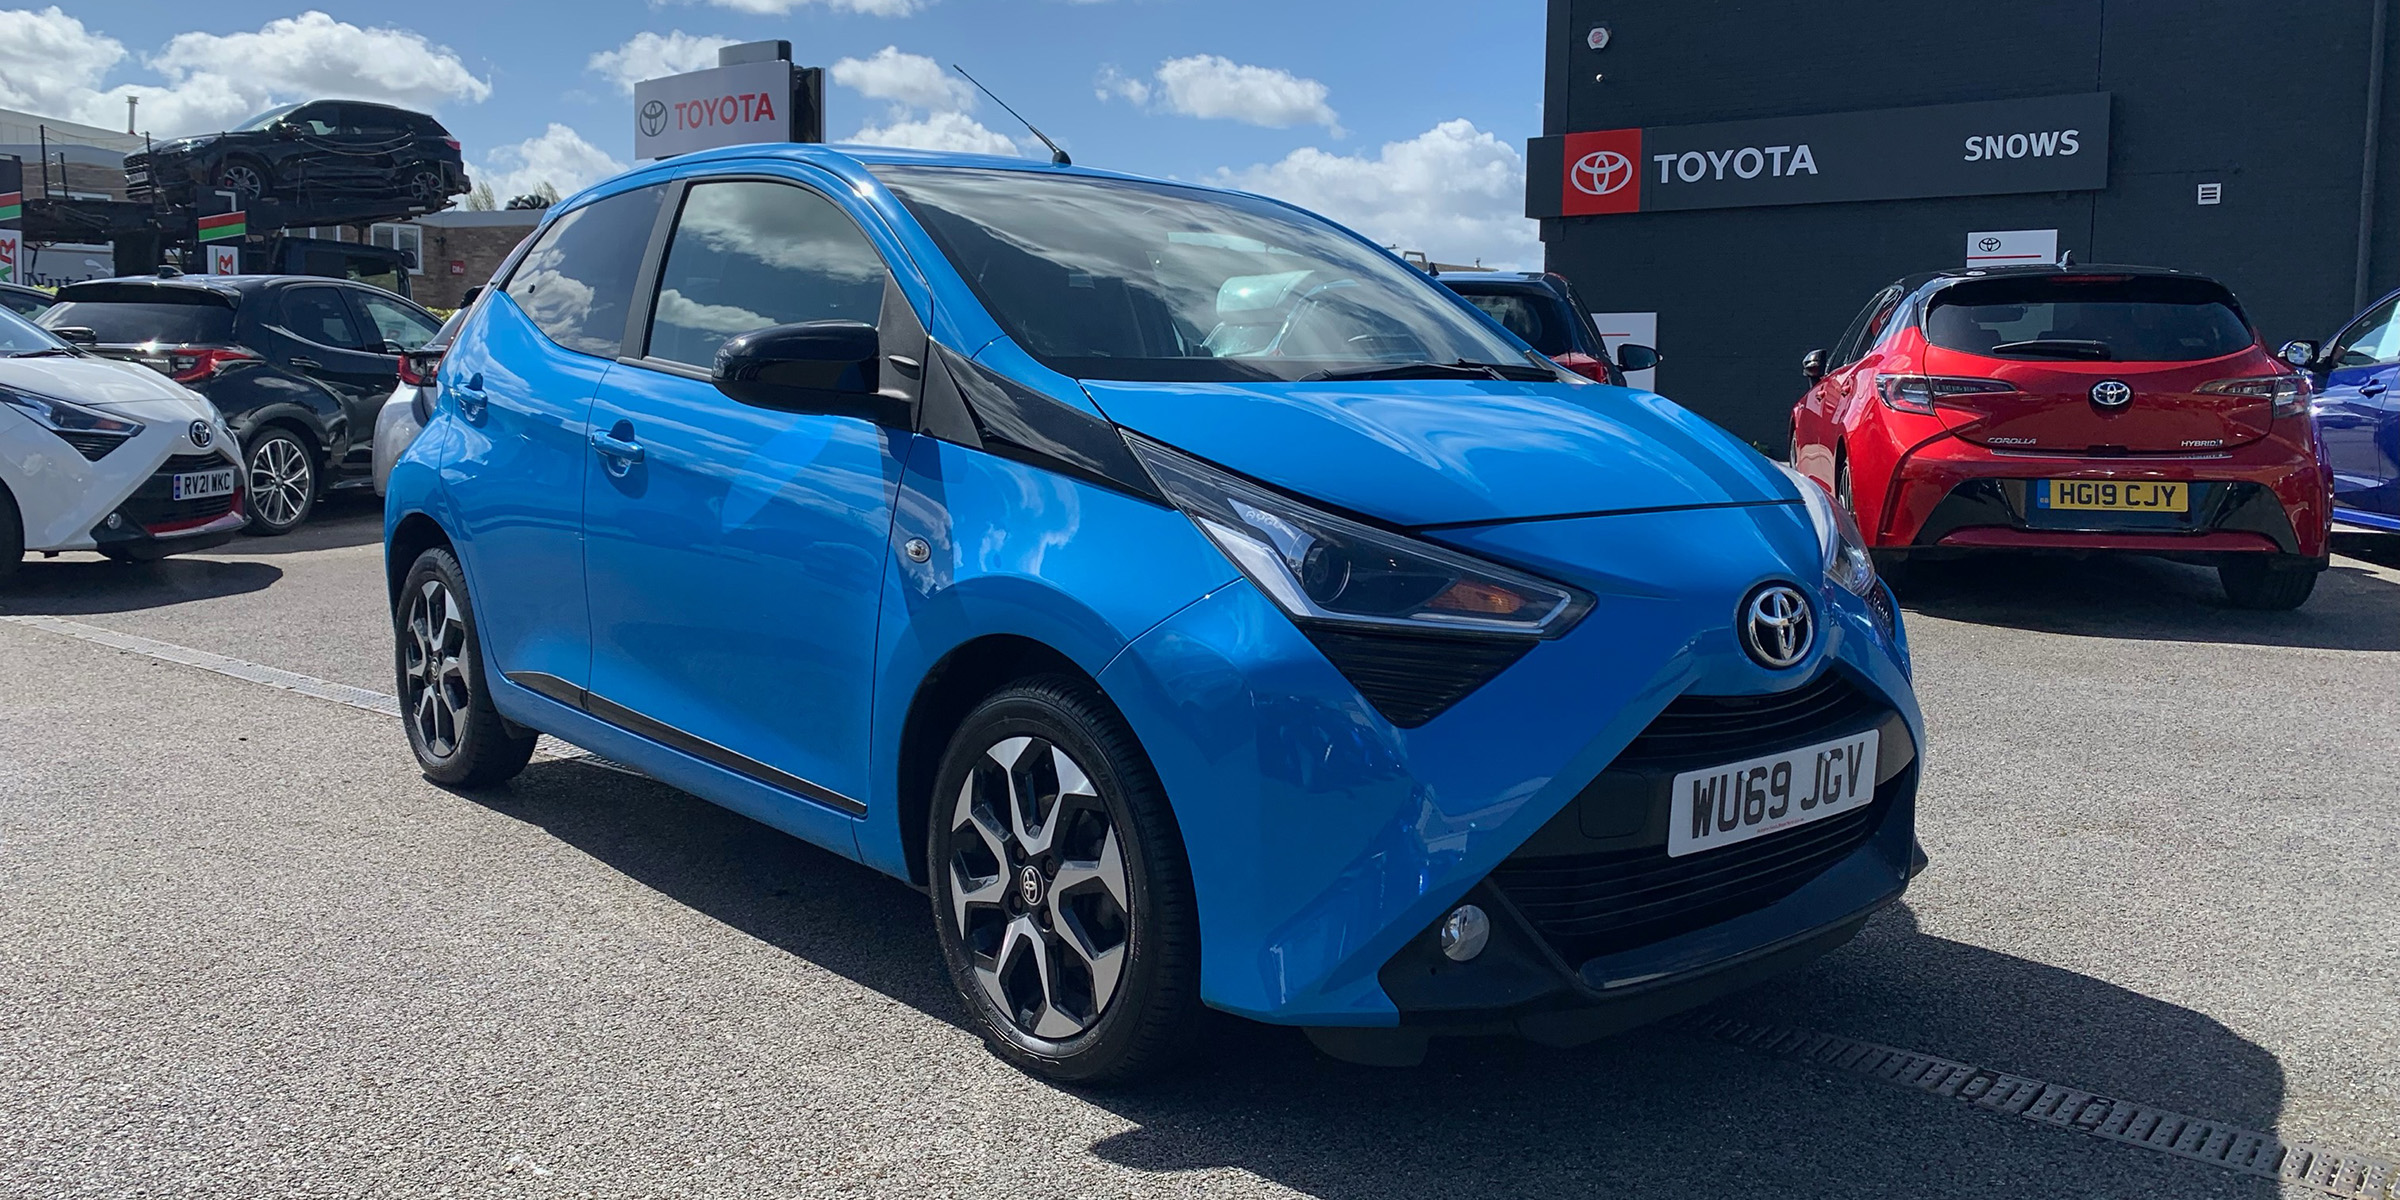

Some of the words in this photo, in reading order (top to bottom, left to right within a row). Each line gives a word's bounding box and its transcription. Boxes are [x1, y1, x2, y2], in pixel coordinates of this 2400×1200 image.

[674, 92, 776, 131] TOYOTA
[1963, 129, 2080, 162] SNOWS
[1653, 144, 1819, 184] TOYOTA
[1987, 437, 2037, 445] COROLLA
[184, 474, 209, 496] RV21
[211, 472, 231, 492] WKC
[2059, 483, 2117, 506] HG19
[2125, 484, 2177, 507] CJY
[1692, 760, 1792, 840] WU69
[1800, 741, 1865, 811] JGV
